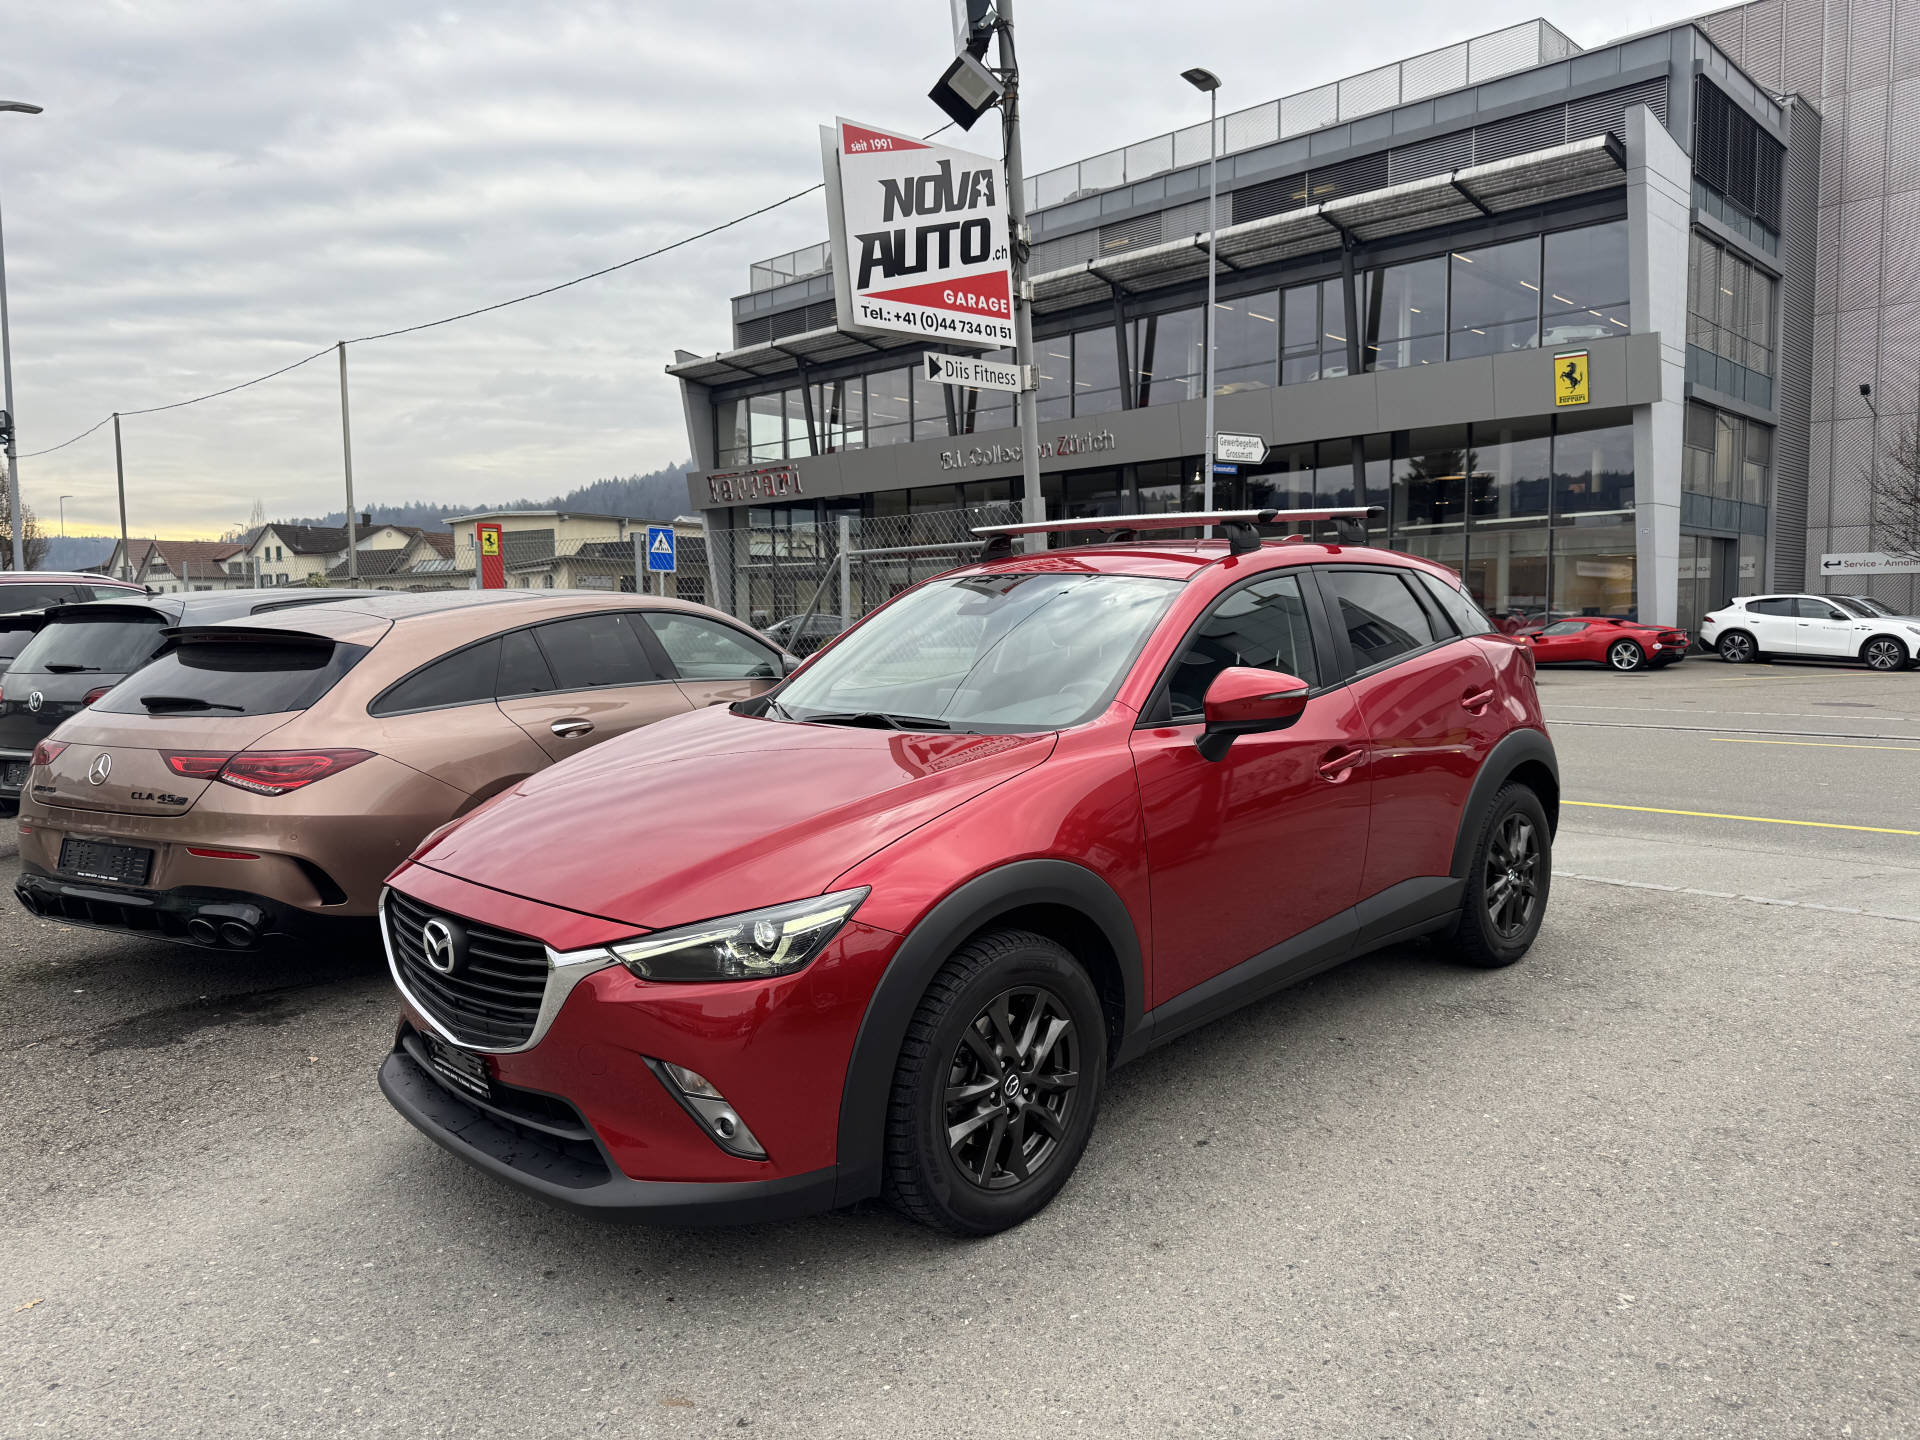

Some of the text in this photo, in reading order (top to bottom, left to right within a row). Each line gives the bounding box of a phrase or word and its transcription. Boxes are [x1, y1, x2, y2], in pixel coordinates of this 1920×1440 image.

[851, 138, 893, 152] seit 1991
[878, 159, 996, 222] NOVA
[854, 218, 991, 290] AUTO
[943, 290, 1008, 313] GARAGE
[861, 305, 891, 322] Tel.:
[894, 312, 917, 325] +41
[958, 320, 982, 336] 734
[985, 324, 997, 337] 01
[1000, 327, 1012, 340] 51
[946, 360, 1016, 386] Diis Fitness
[1056, 429, 1116, 456] Zürich
[1844, 560, 1877, 568] Service
[130, 791, 154, 801] CLA
